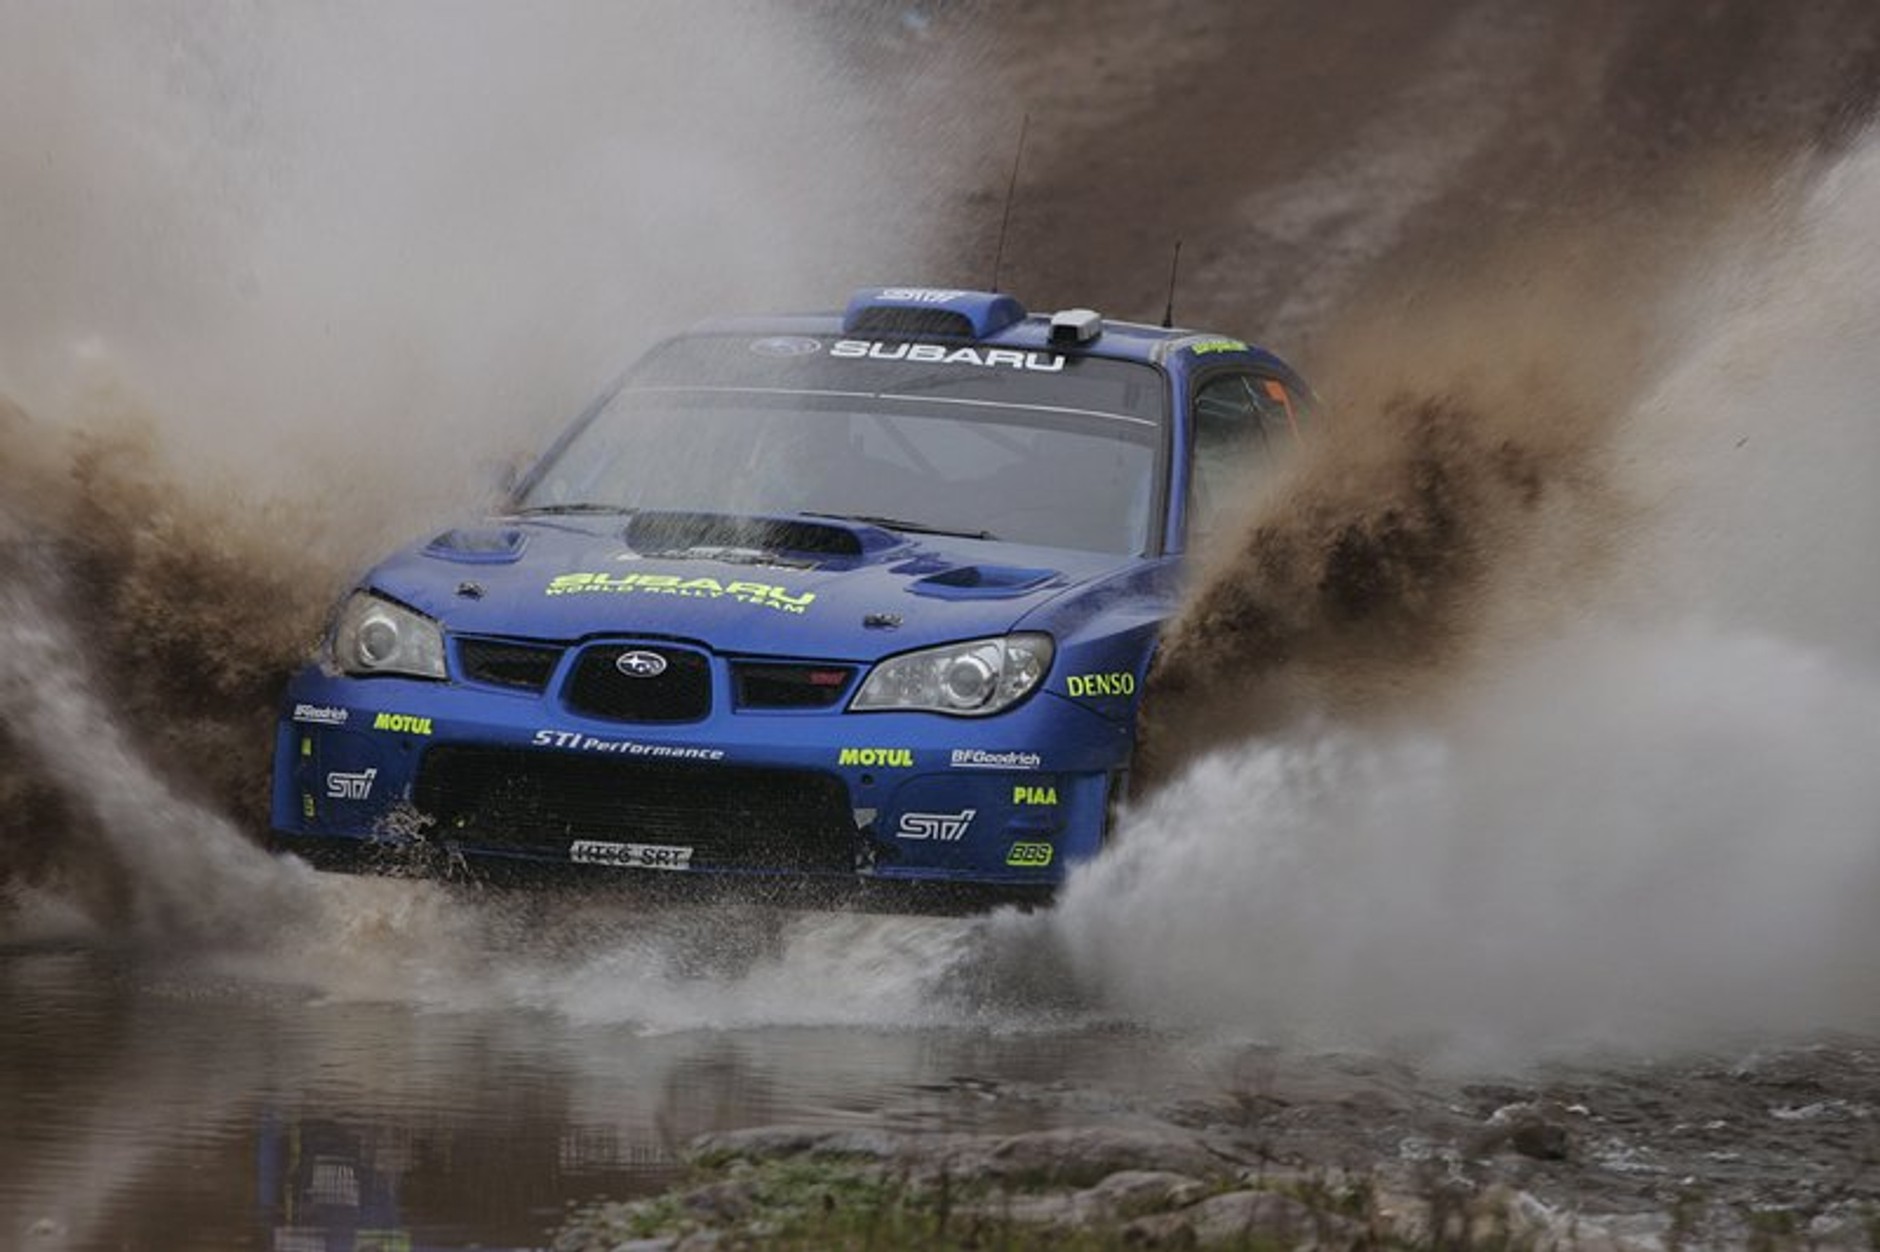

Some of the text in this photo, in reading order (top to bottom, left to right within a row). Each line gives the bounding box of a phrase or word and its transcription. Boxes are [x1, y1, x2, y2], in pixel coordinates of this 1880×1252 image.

[829, 339, 1067, 372] SUBARU
[545, 584, 805, 615] WORLD RALLY TEAM
[550, 573, 816, 605] SUBARU
[1066, 672, 1135, 697] DENSO
[373, 712, 433, 735] MOTUL
[582, 737, 725, 761] Performance
[838, 748, 913, 767] MOTUL
[951, 749, 1041, 766] BFGoodrich
[1013, 787, 1057, 805] PIAA
[641, 847, 687, 866] SRT
[1009, 843, 1050, 863] BBS
